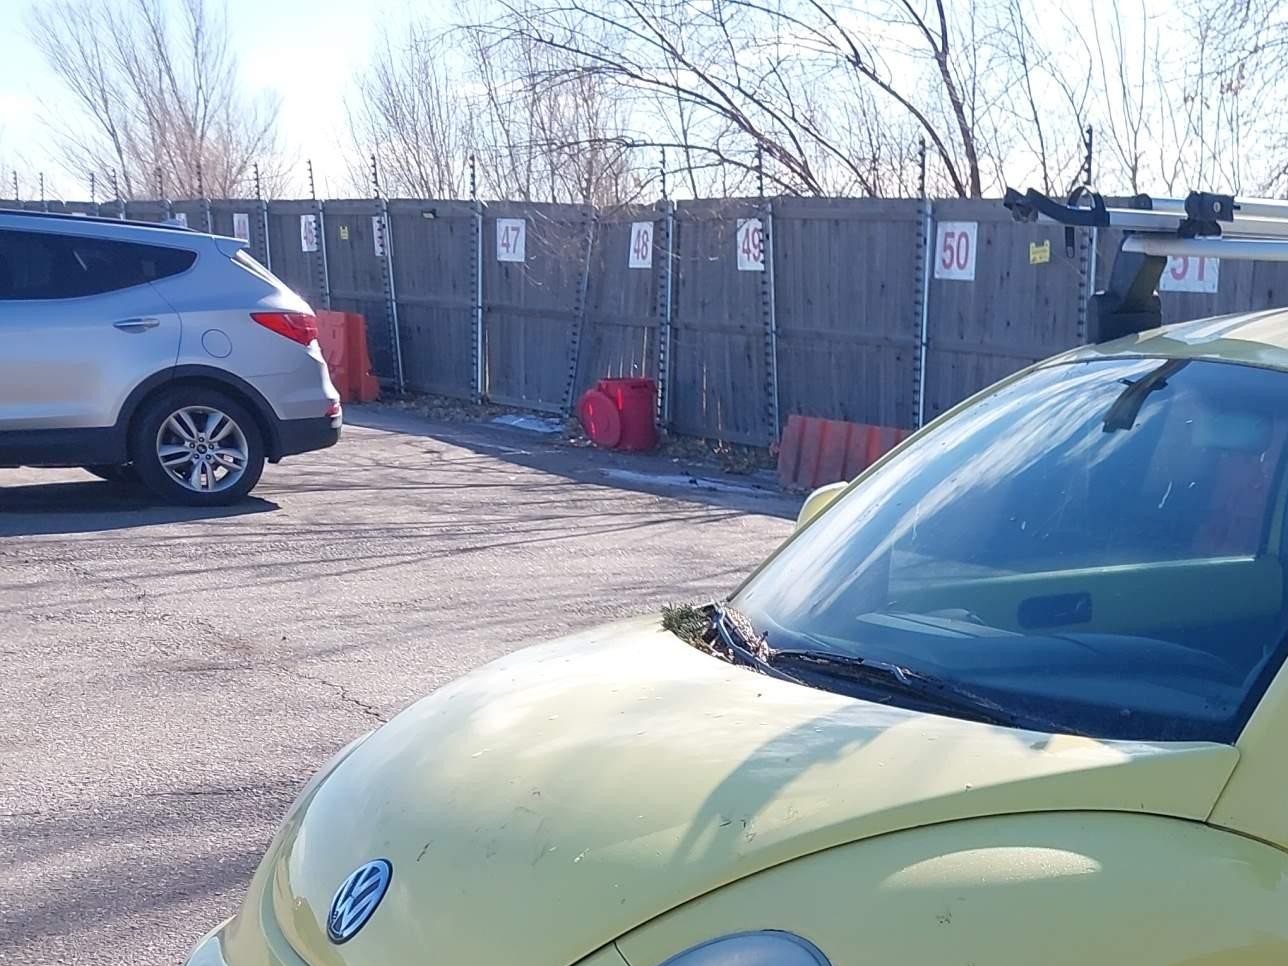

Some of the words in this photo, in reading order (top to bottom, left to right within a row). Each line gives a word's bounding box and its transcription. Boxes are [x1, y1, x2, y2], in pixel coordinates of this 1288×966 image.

[501, 226, 521, 254] 47
[633, 229, 650, 261] 48
[742, 227, 761, 262] 49
[941, 231, 970, 271] 50
